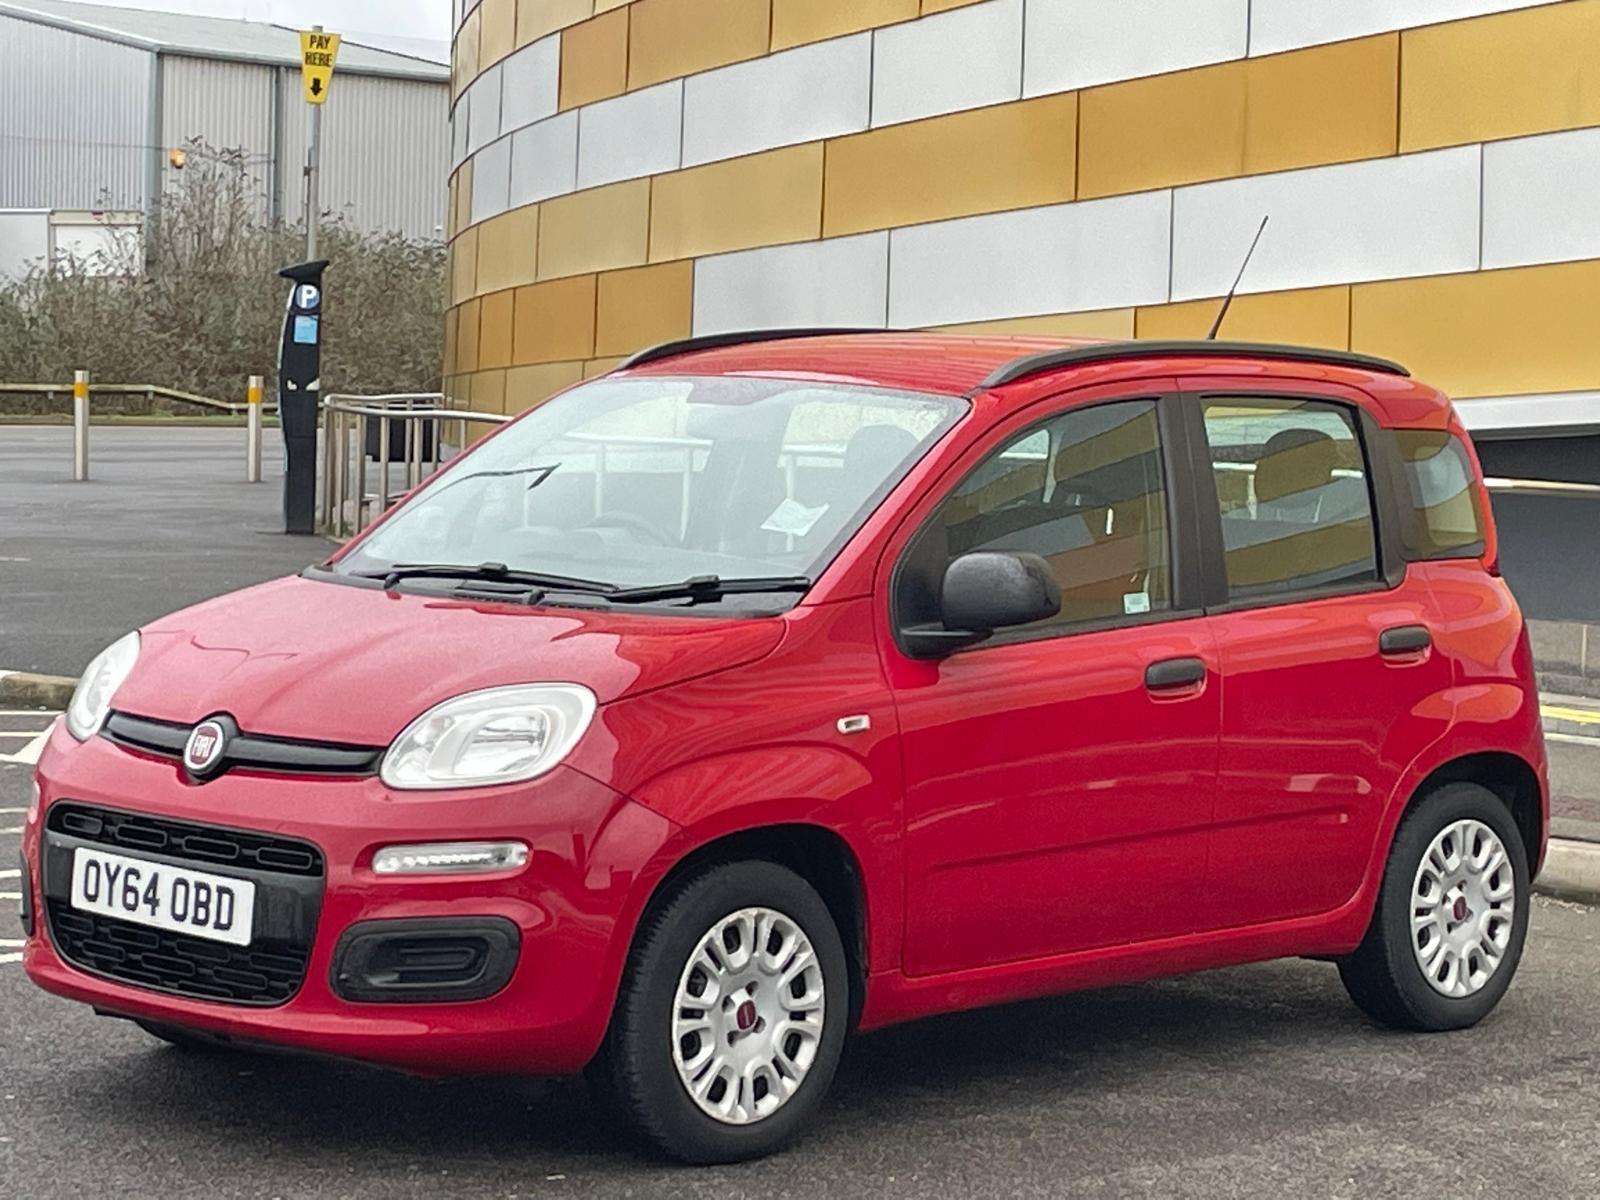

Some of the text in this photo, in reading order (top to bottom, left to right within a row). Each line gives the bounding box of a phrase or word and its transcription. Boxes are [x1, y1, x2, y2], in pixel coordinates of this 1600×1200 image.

[309, 35, 331, 49] PAY
[305, 52, 332, 67] HERE
[301, 284, 317, 308] P
[192, 734, 216, 758] FIAT
[83, 859, 235, 931] OY64 OBD
